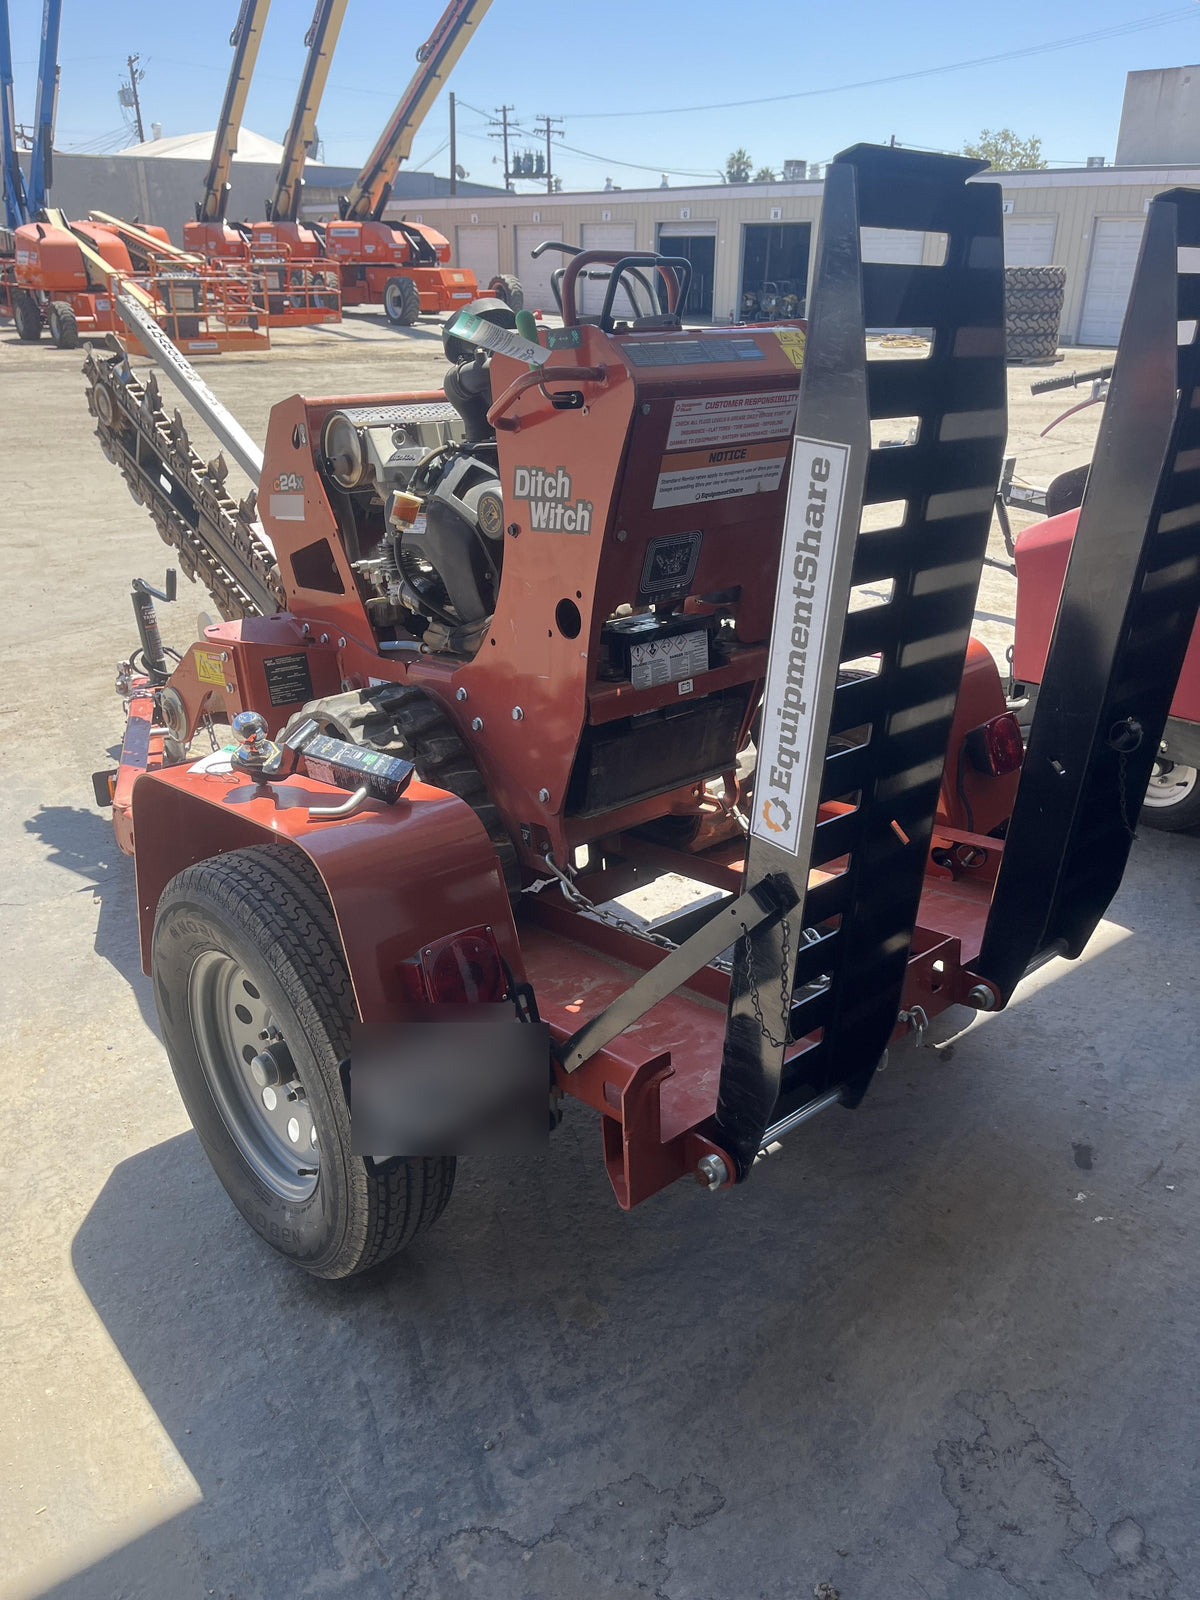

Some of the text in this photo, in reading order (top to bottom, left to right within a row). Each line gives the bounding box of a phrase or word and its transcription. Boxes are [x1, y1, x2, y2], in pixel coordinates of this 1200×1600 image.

[705, 394, 799, 410] CUSTOMER RESPONSIBILITY
[709, 449, 747, 463] NOTICE
[514, 468, 570, 498] Ditch
[700, 487, 744, 499] EquipmentShare
[530, 501, 590, 531] Witch
[769, 456, 831, 795] EquipmentShare
